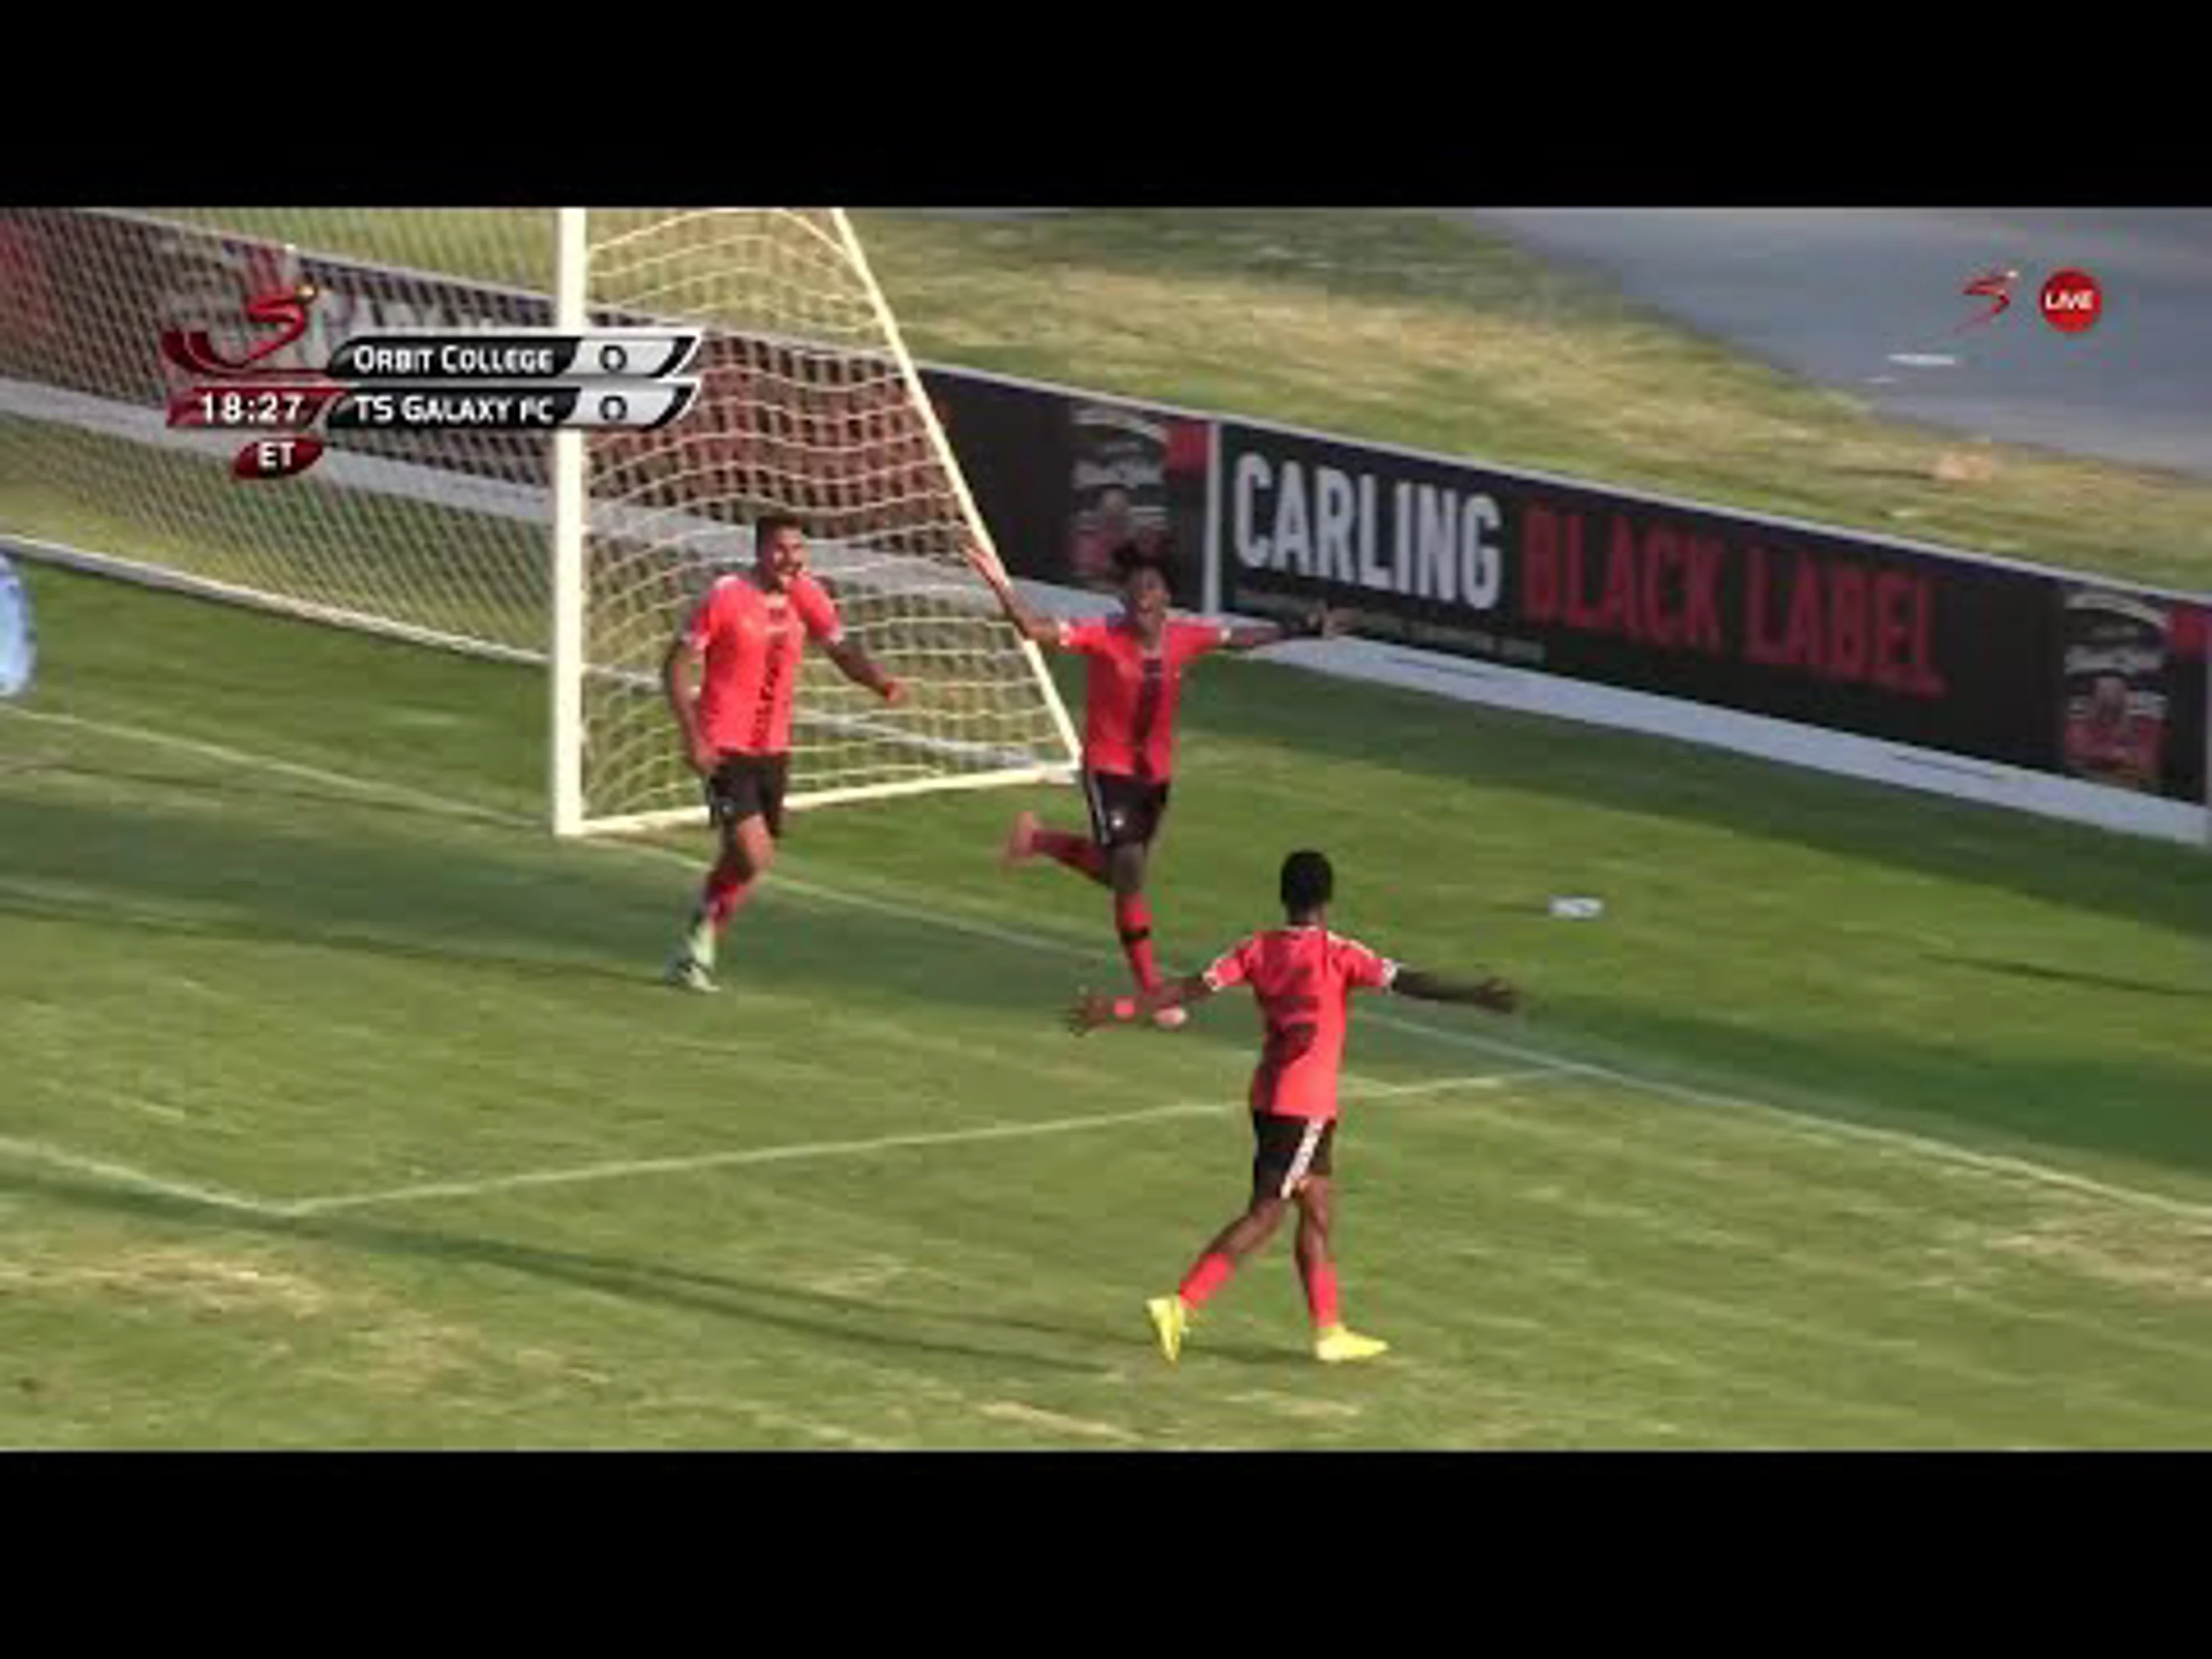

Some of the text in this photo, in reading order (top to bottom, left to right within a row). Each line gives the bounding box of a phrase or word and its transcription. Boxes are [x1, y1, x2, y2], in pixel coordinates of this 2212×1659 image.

[1233, 452, 1500, 611] CARLING
[1521, 507, 1721, 651] BLACK
[1743, 547, 1948, 698] LABEL
